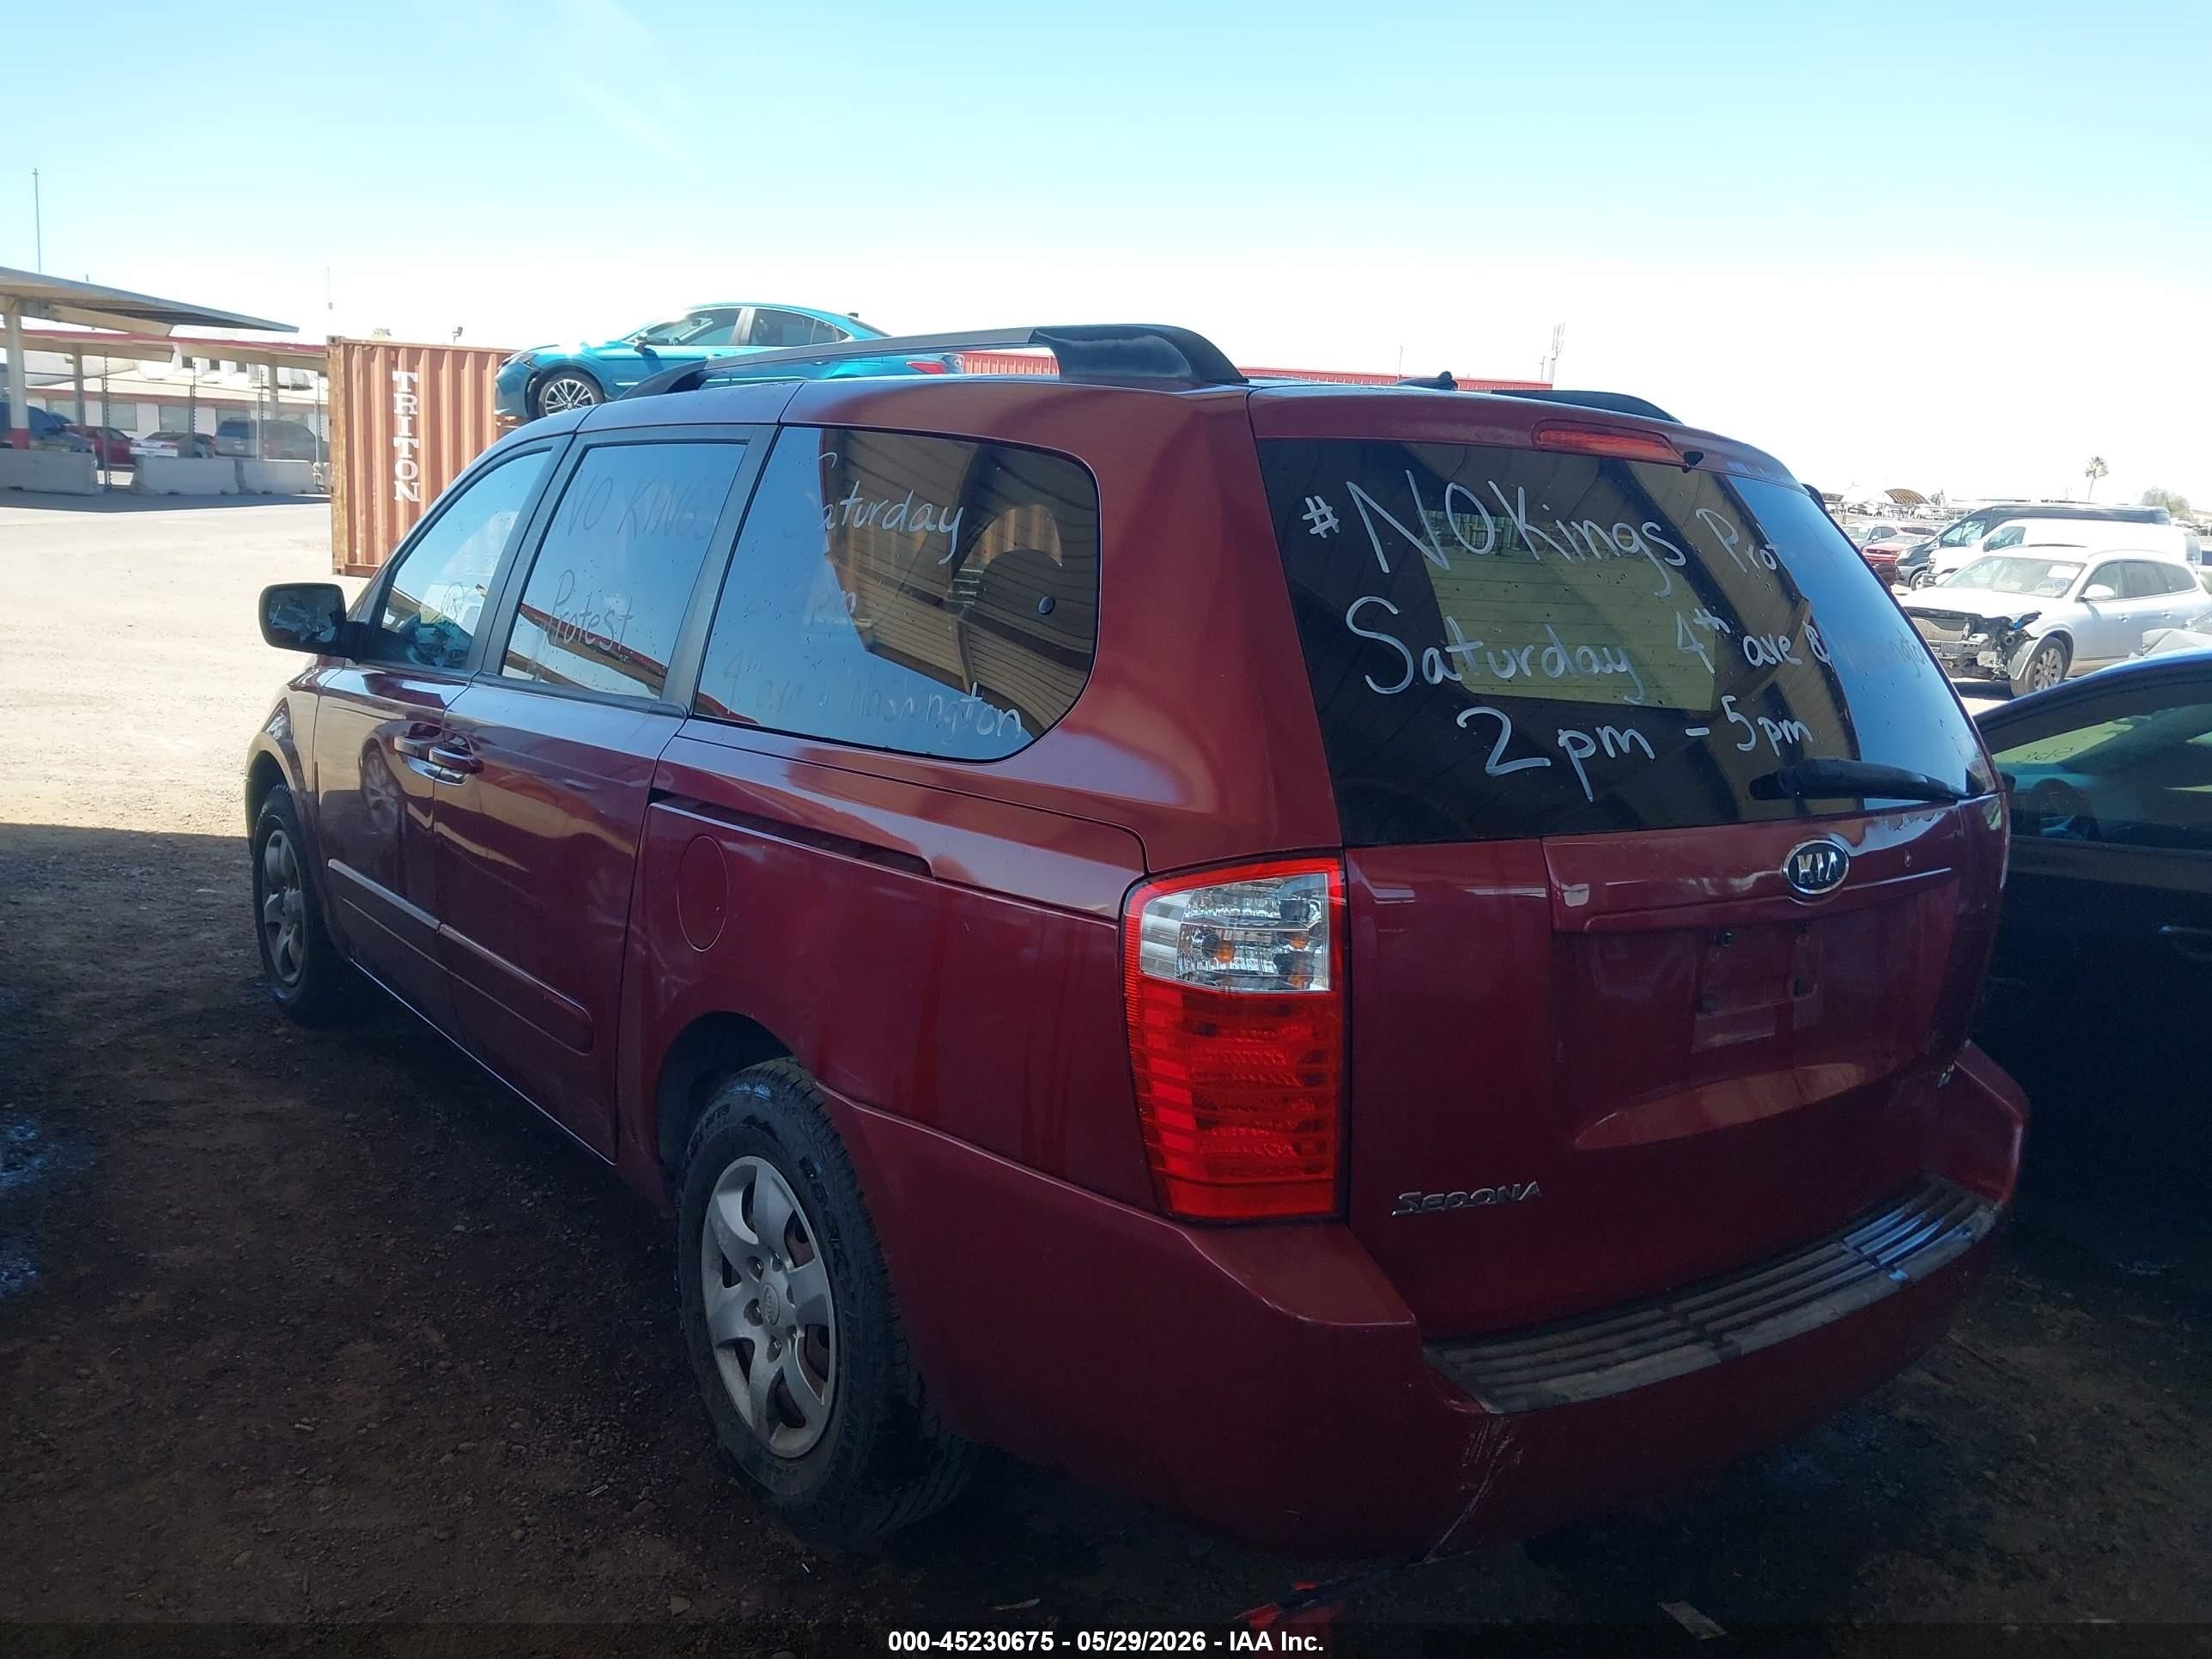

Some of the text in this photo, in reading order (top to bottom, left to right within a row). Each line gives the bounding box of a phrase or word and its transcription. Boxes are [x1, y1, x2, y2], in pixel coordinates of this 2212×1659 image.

[392, 370, 420, 502] TRITON
[546, 569, 633, 650] Protest
[1346, 596, 1647, 704] Saturday
[1674, 608, 1731, 674] 4th
[1743, 632, 1802, 667] ave
[1456, 706, 1552, 776] 2
[1796, 850, 1841, 884] KIA
[1391, 1180, 1543, 1217] SEDONA
